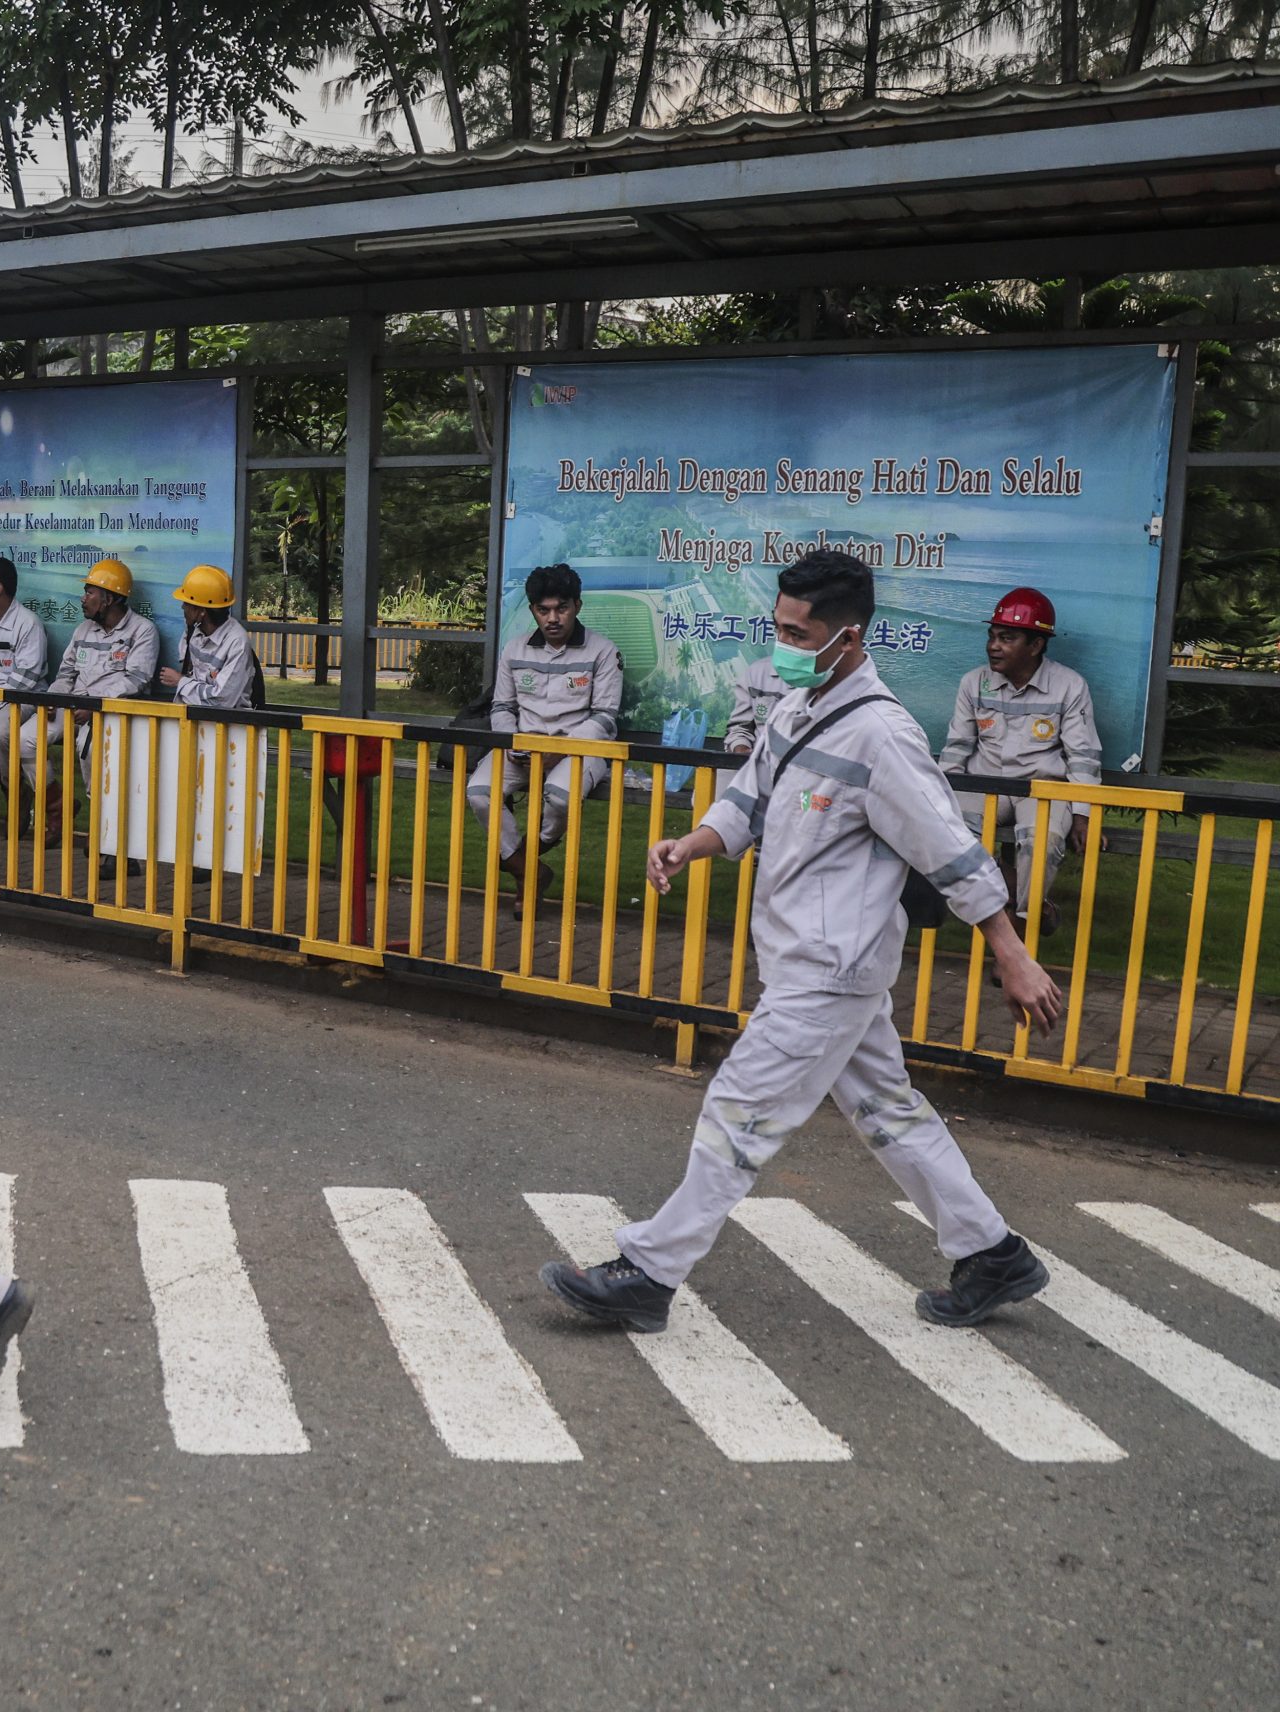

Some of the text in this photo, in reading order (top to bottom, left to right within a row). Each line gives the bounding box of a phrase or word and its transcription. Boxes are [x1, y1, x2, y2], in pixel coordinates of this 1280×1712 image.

[20, 479, 55, 497] Berani
[59, 478, 139, 497] Melaksanakan
[144, 477, 207, 500] Tanggung
[557, 456, 1081, 504] Bekerjalah Dengan Senang Hati Dan Selalu
[25, 512, 95, 530] Keselamatan
[99, 512, 123, 530] Dan
[128, 512, 199, 535] Mendorong
[9, 545, 37, 567] Yang
[658, 528, 753, 573] Menjaga
[893, 532, 946, 569] Diri
[663, 611, 934, 653] 快乐工作 生活
